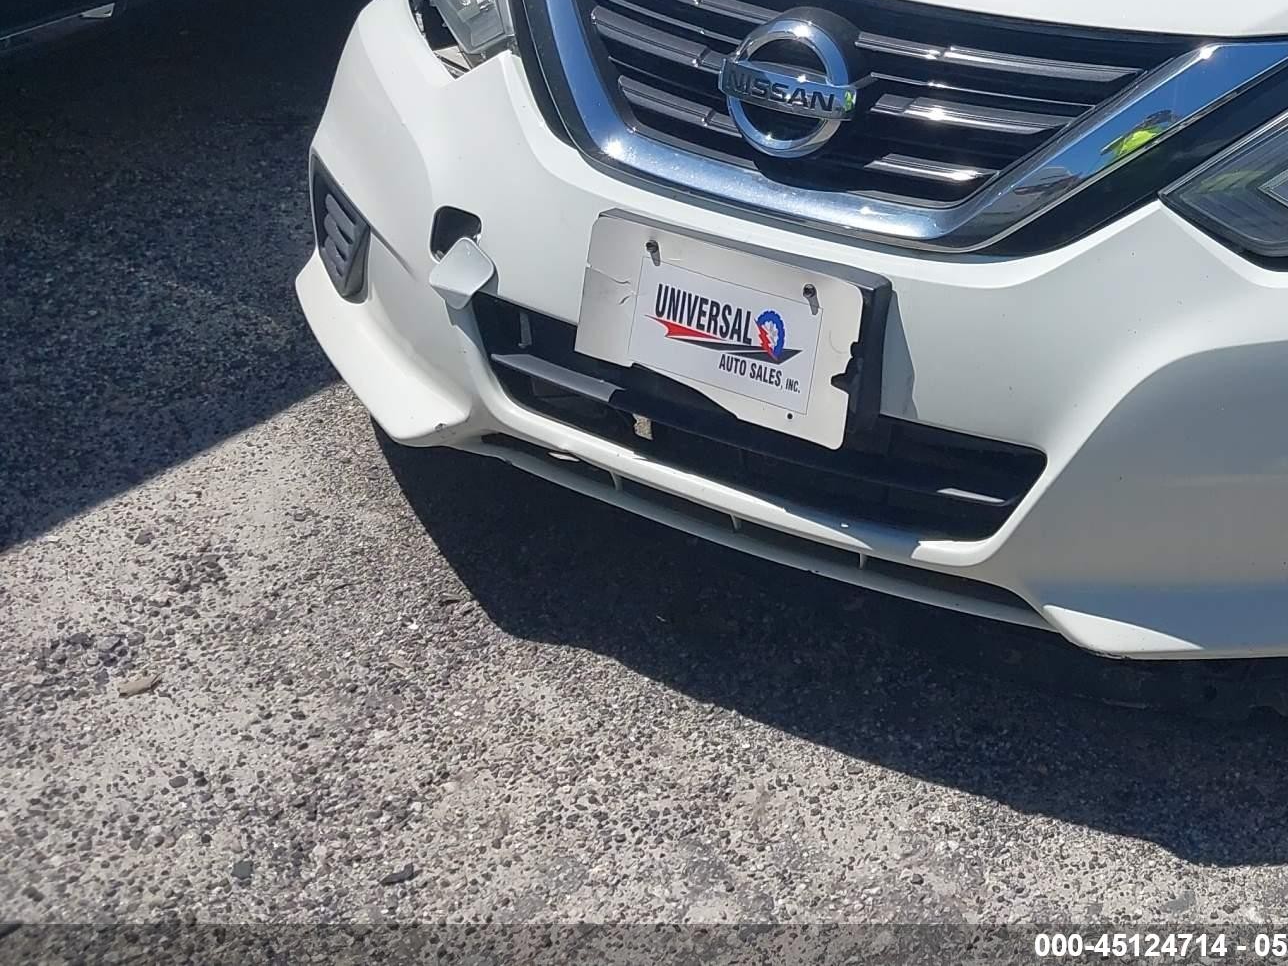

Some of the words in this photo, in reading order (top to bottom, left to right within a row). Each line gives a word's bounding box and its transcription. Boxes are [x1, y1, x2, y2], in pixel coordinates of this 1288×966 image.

[728, 69, 836, 113] NISSAN
[654, 283, 753, 346] UNIVERSAL
[718, 353, 747, 376] AUTO
[785, 378, 801, 395] INC.
